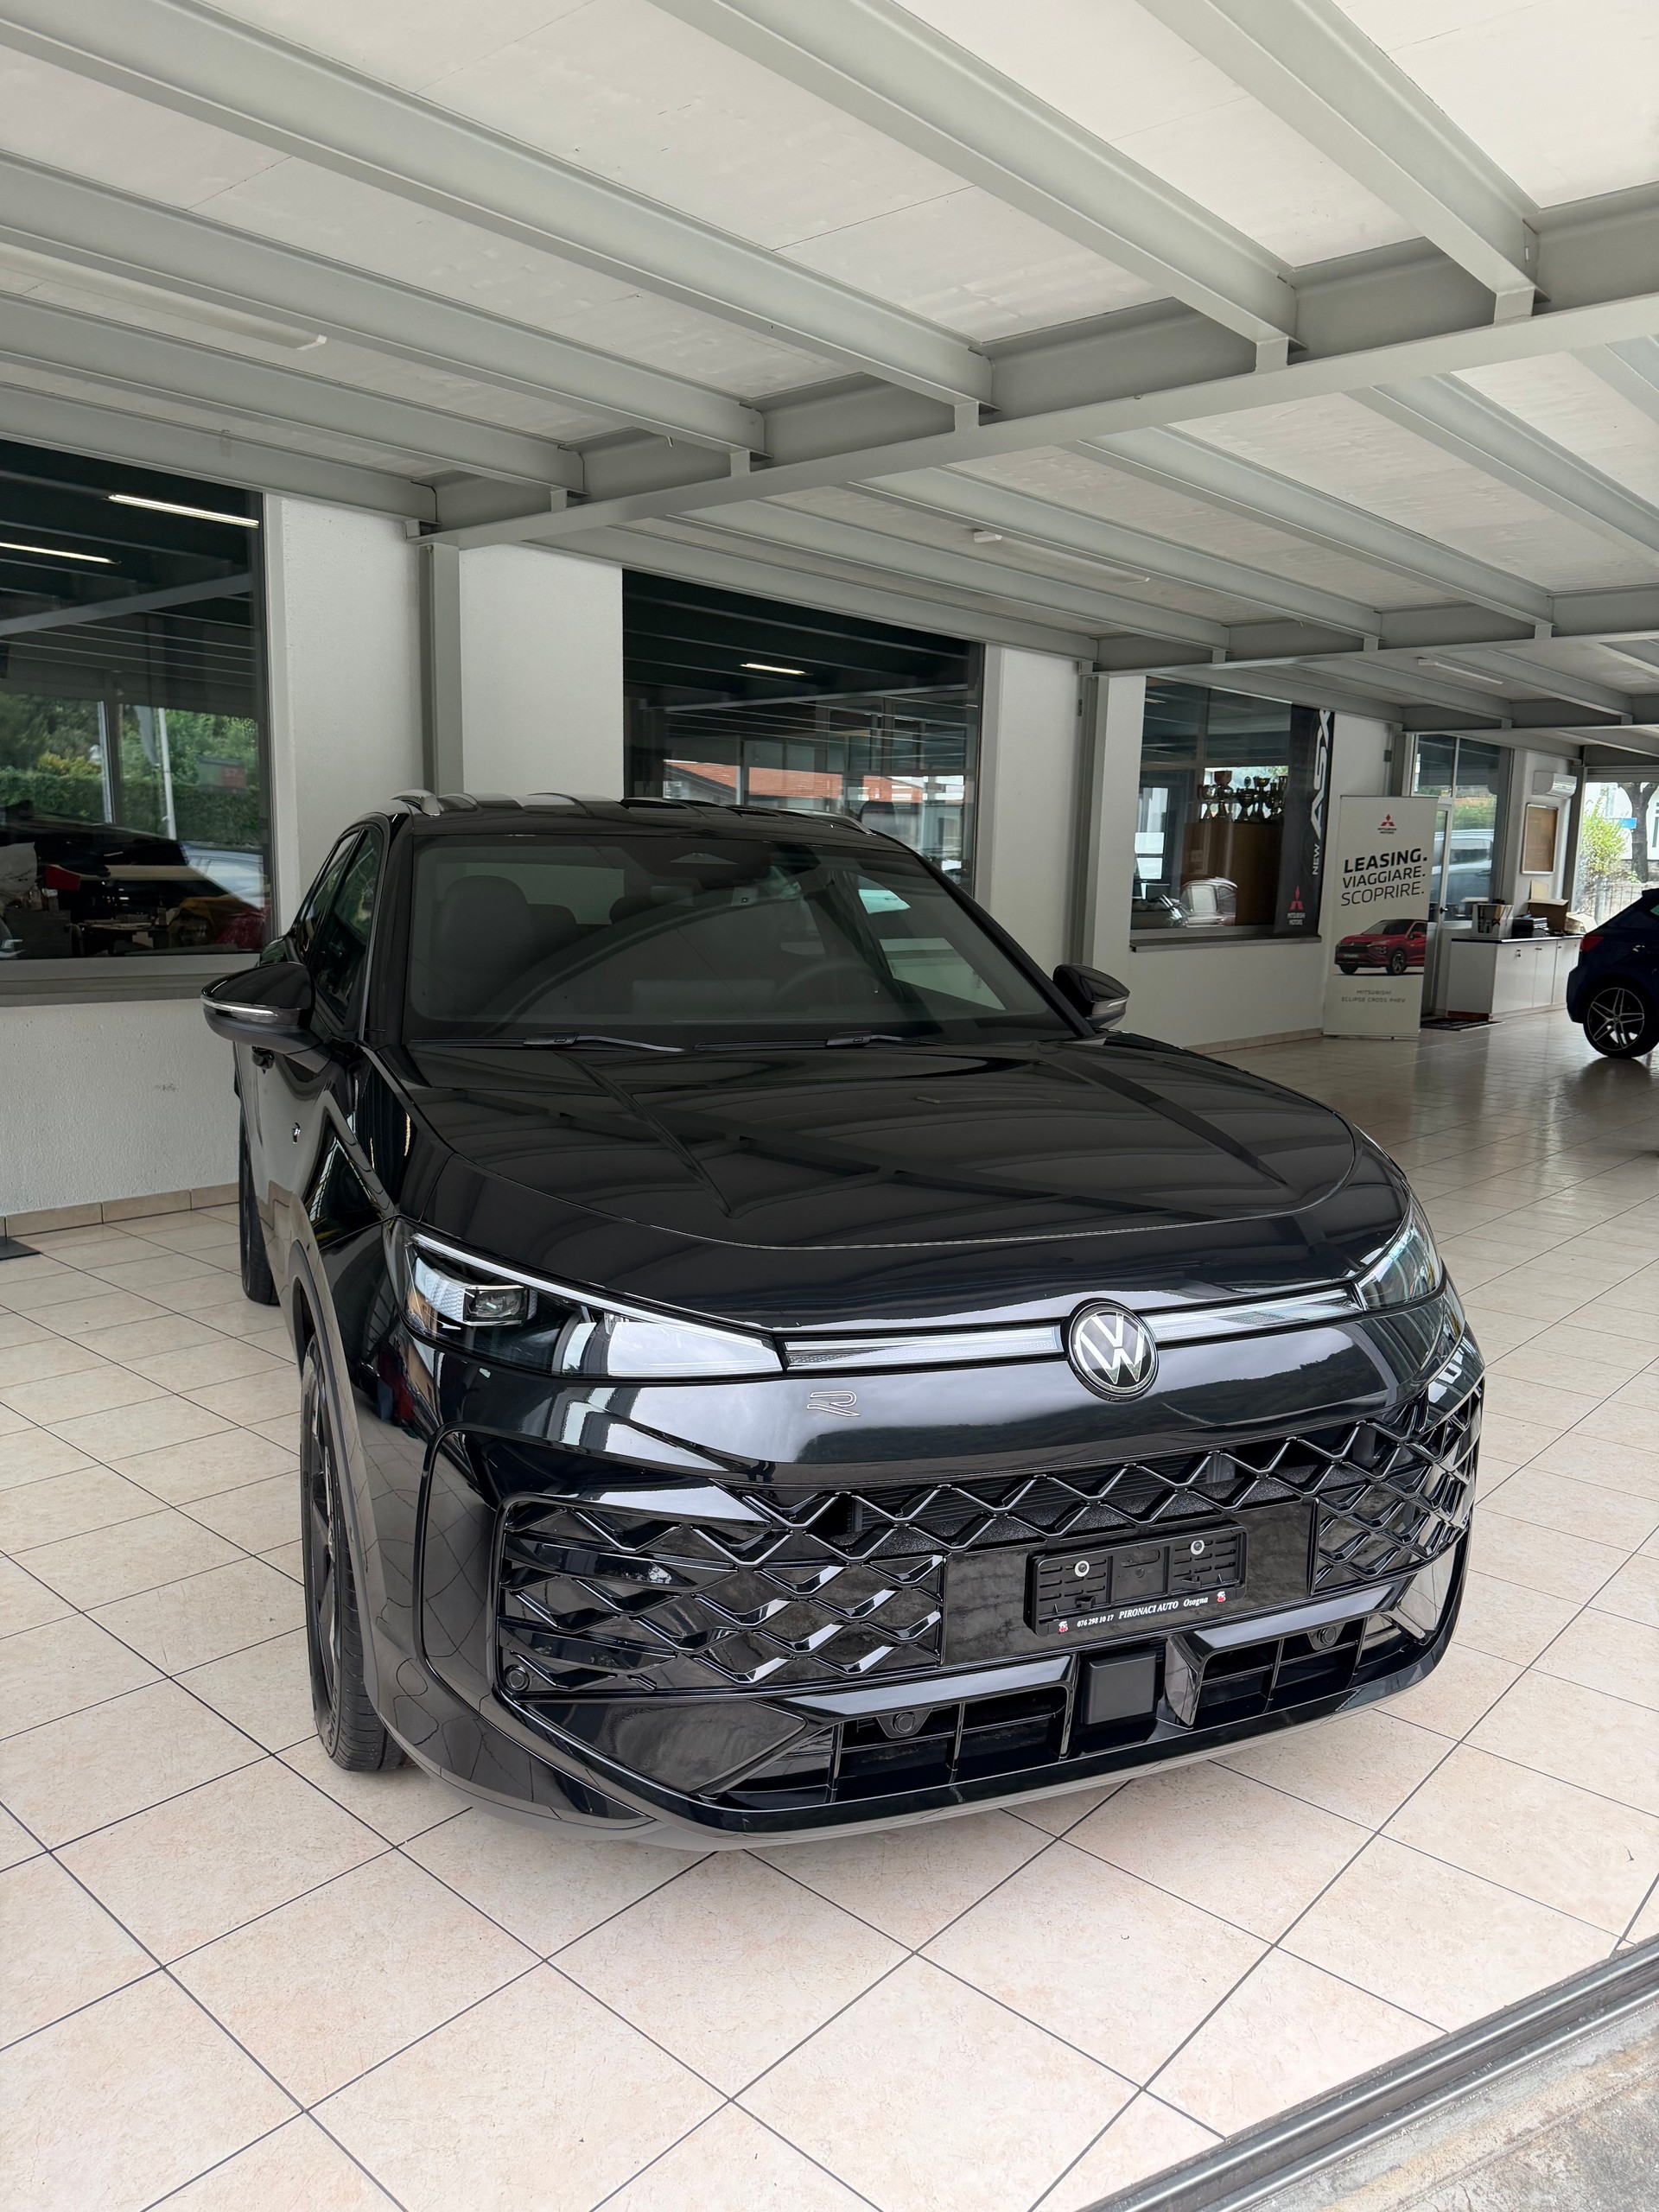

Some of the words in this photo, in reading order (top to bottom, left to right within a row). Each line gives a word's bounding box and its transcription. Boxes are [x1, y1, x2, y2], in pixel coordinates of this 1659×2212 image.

[1311, 710, 1332, 840] ASX
[1312, 843, 1320, 875] NEW
[1344, 848, 1427, 874] LEASING.
[1343, 866, 1426, 888] VIAGGIARE.
[1341, 881, 1424, 906] SCOPRIRE.
[1088, 1617, 1099, 1625] 298
[1118, 1604, 1158, 1619] PIRONACI
[1157, 1600, 1179, 1613] AUTO
[1183, 1597, 1209, 1607] Osogna
